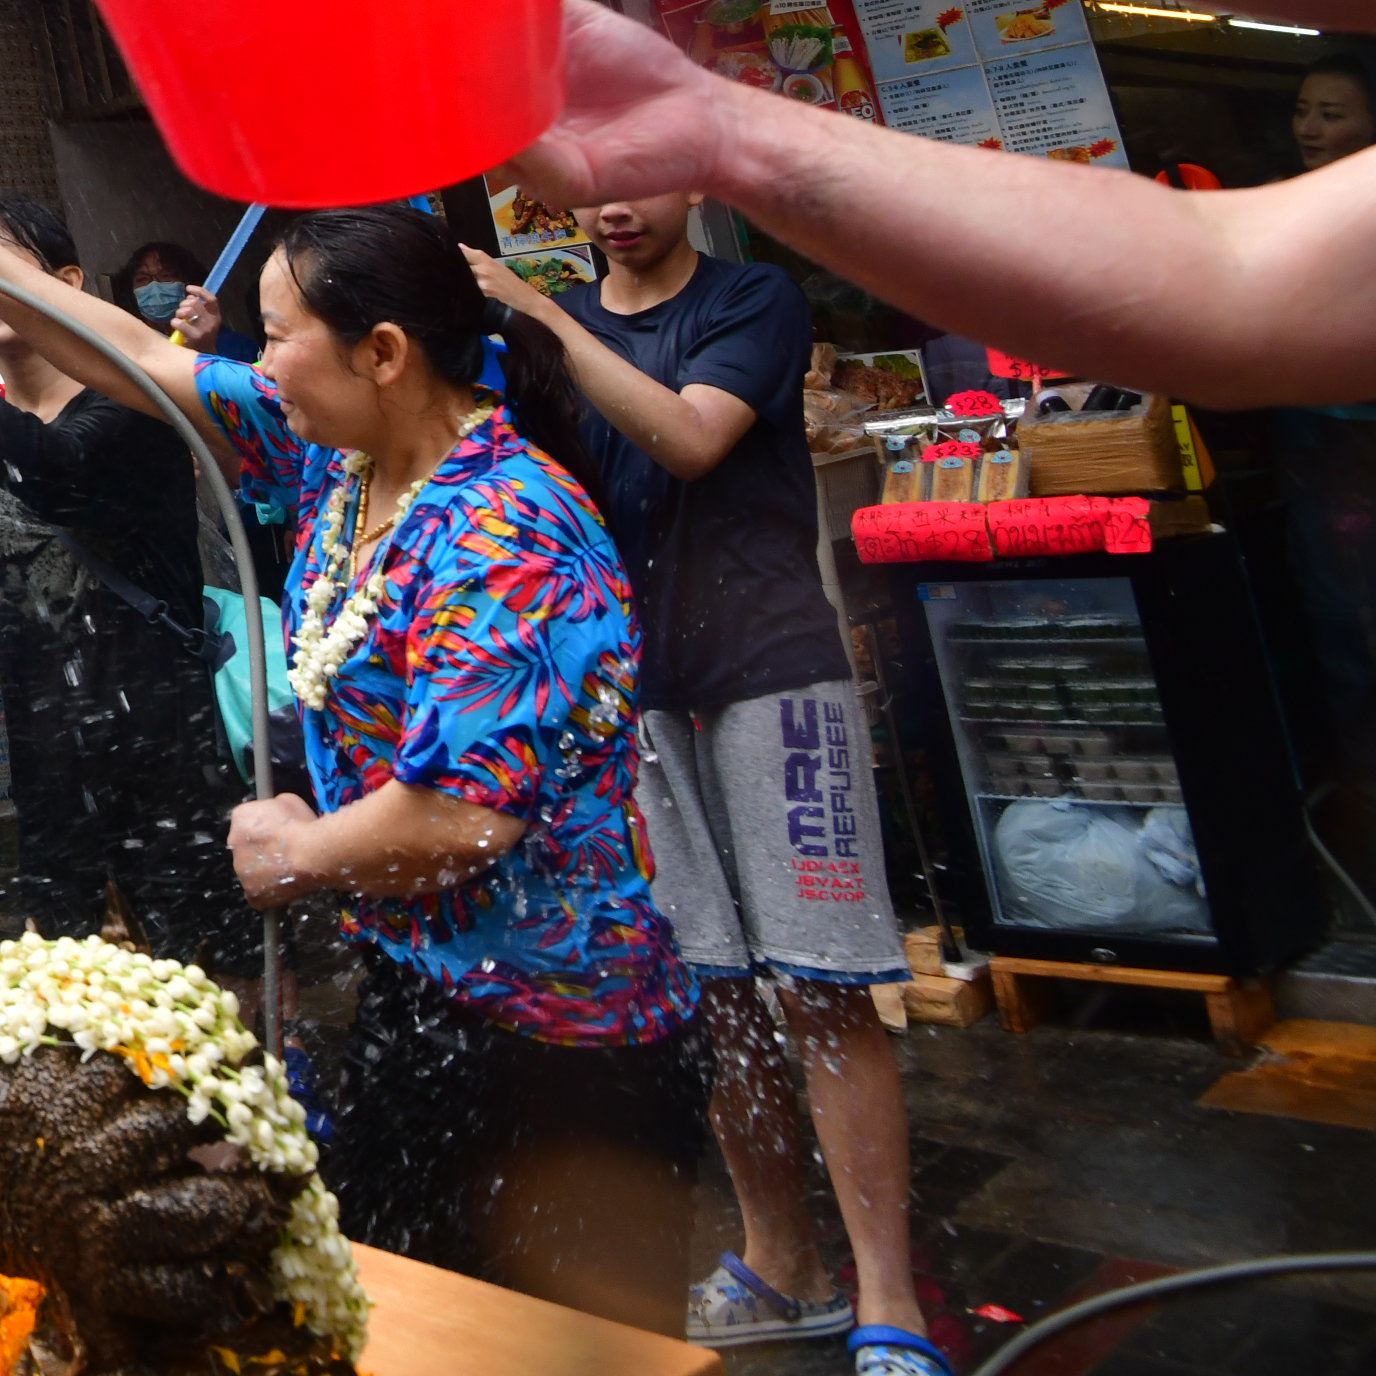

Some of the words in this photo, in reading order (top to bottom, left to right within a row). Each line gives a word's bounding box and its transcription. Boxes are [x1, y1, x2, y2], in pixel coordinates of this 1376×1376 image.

[956, 396, 993, 411] $28
[935, 445, 973, 458] $23
[780, 699, 828, 856] MRE
